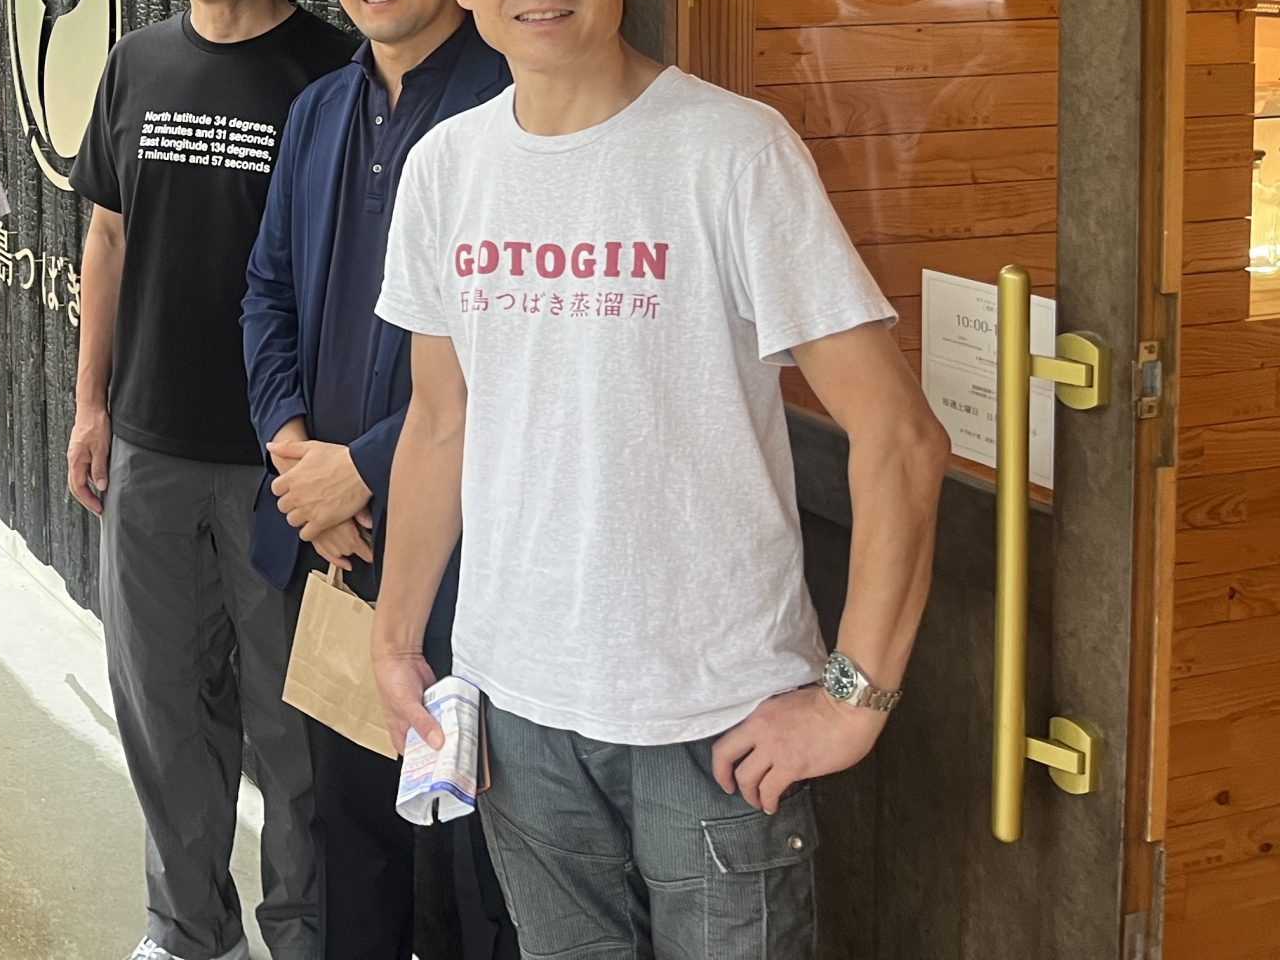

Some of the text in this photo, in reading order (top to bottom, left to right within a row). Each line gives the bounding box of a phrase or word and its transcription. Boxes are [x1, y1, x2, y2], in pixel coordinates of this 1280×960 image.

[145, 111, 277, 135] North latitude 34 degrees,
[142, 124, 275, 147] 20 minutes and 31 seconds
[139, 136, 272, 161] East longitude 134 degrees,
[137, 149, 270, 174] 2 minutes and 57 seconds
